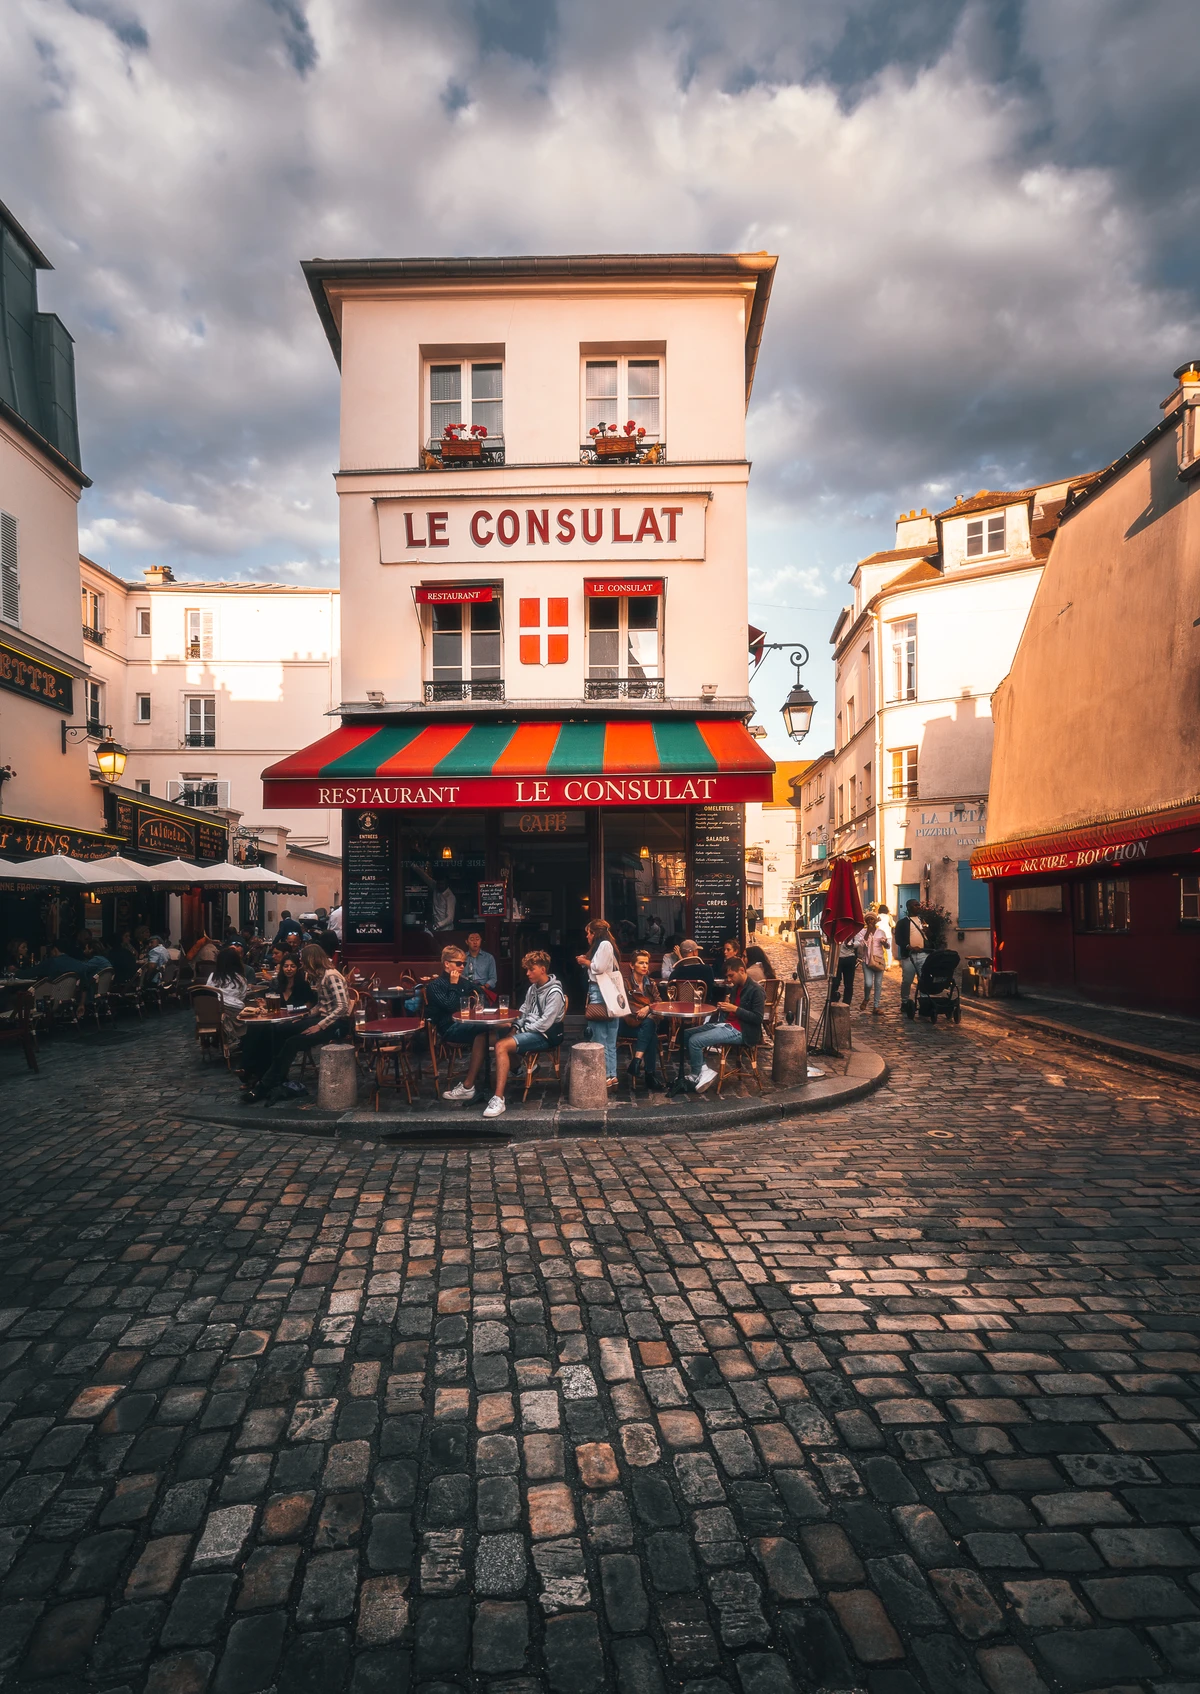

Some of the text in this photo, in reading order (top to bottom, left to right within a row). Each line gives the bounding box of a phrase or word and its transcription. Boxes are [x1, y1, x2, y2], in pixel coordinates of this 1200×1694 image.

[403, 507, 684, 549] LE CONSULAT
[427, 591, 481, 600] RESTAURANT
[593, 583, 653, 592] LE CONSULAT
[318, 786, 460, 804] RESTAURANT
[515, 778, 717, 802] LE CONSULAT
[518, 811, 568, 833] CAFÉ
[921, 812, 939, 825] LA
[916, 827, 958, 837] PIZZERIA
[25, 829, 70, 856] VINS
[1075, 840, 1149, 867] BOUCHON
